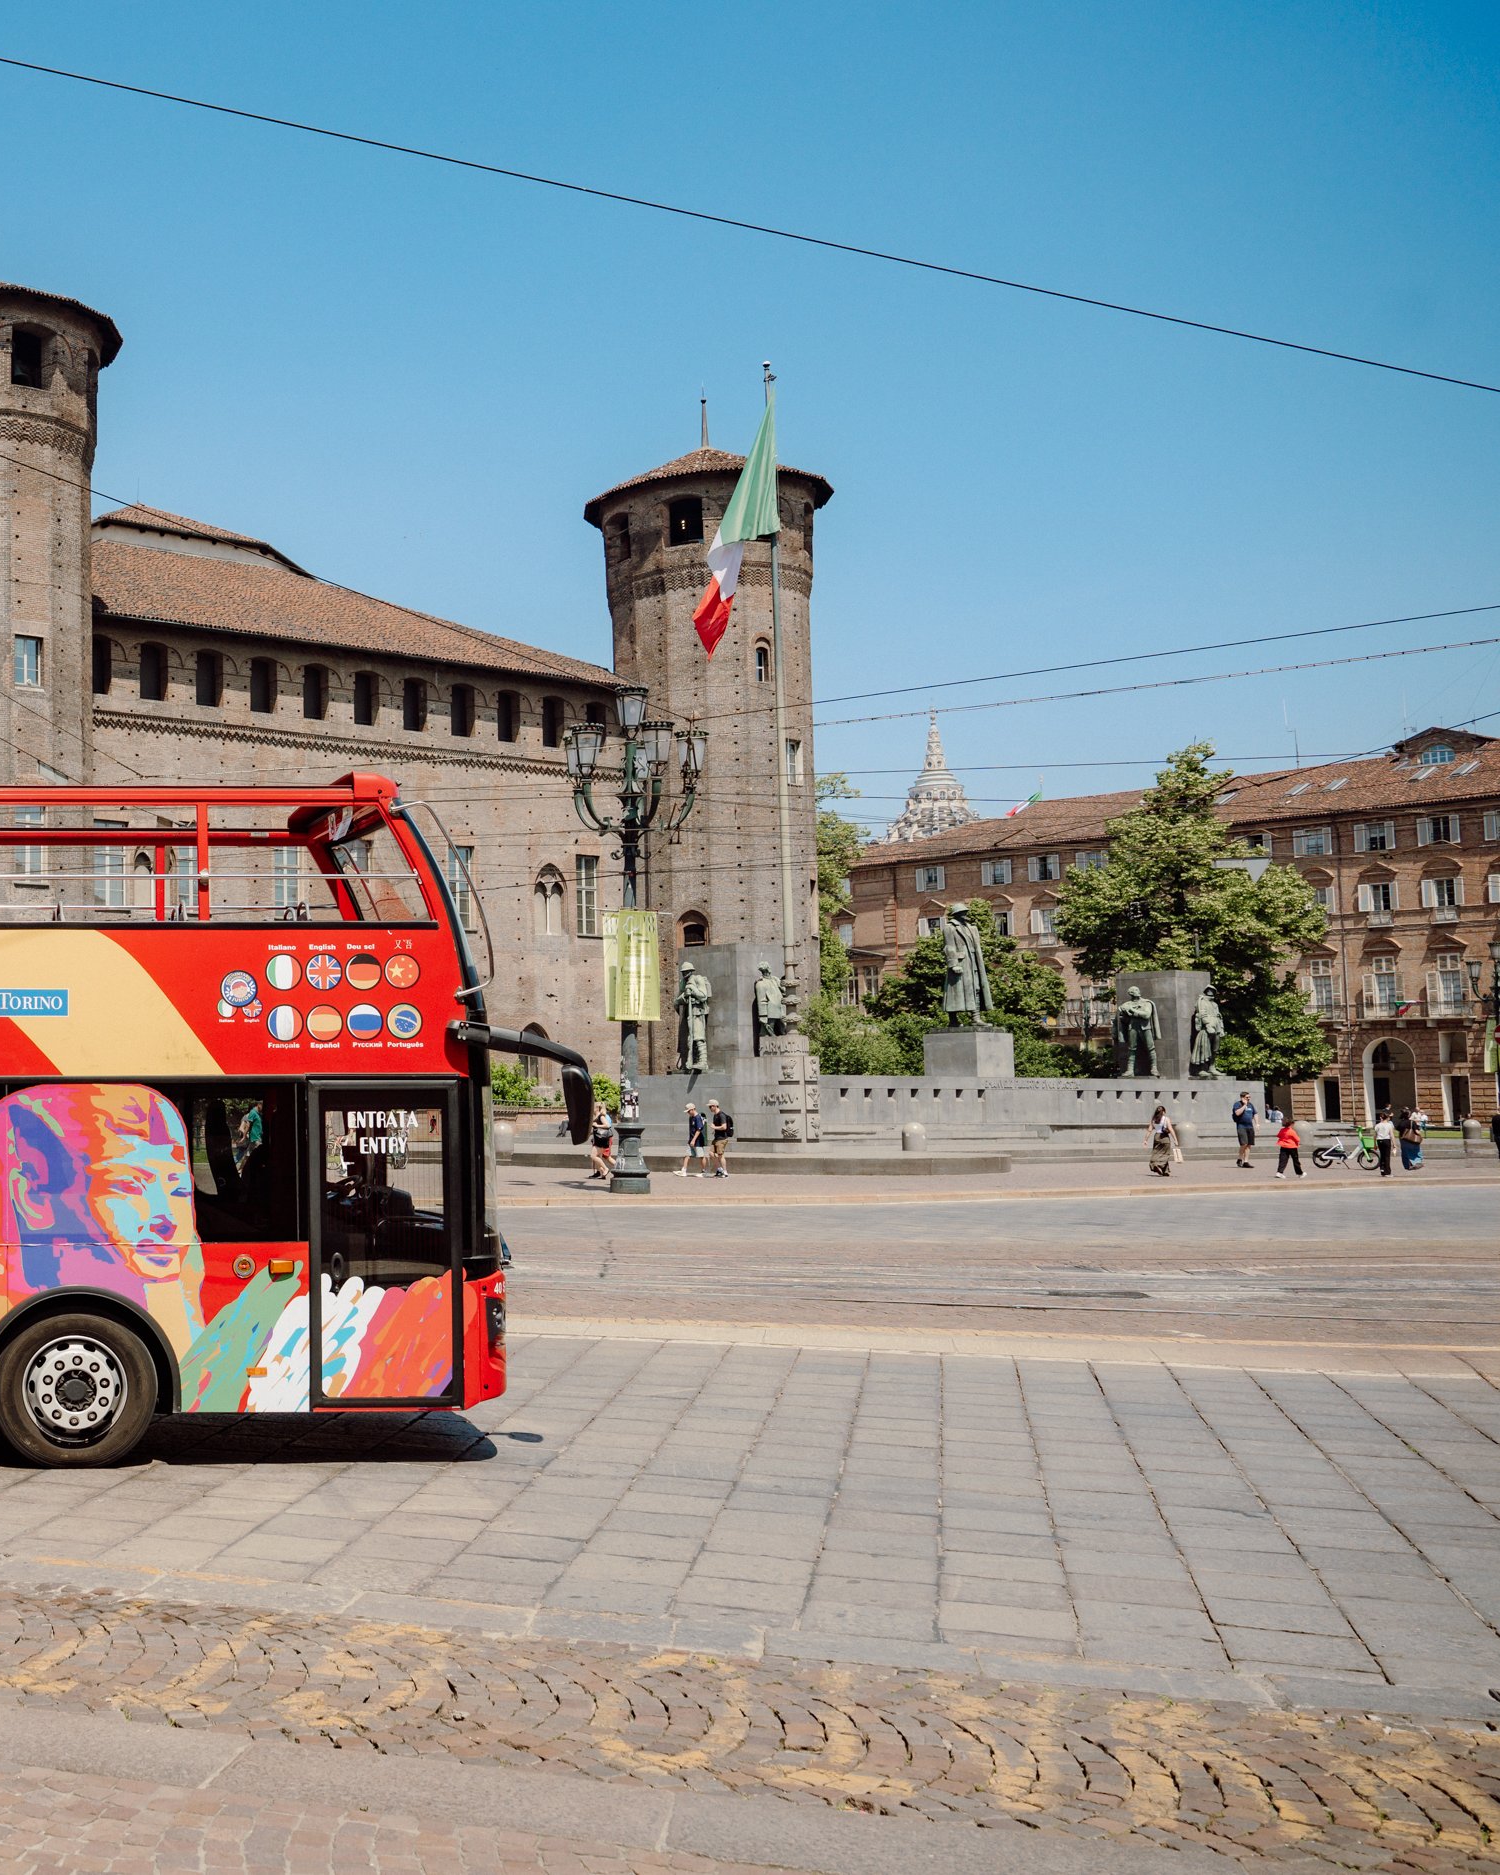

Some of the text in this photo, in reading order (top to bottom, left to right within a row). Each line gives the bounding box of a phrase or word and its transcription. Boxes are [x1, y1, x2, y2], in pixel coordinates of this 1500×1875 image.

[308, 943, 337, 952] English
[268, 1041, 300, 1049] Français
[310, 1041, 340, 1049] Español
[387, 1041, 424, 1049] Português
[347, 1110, 418, 1129] ENTRATA
[359, 1136, 408, 1154] ENTRY
